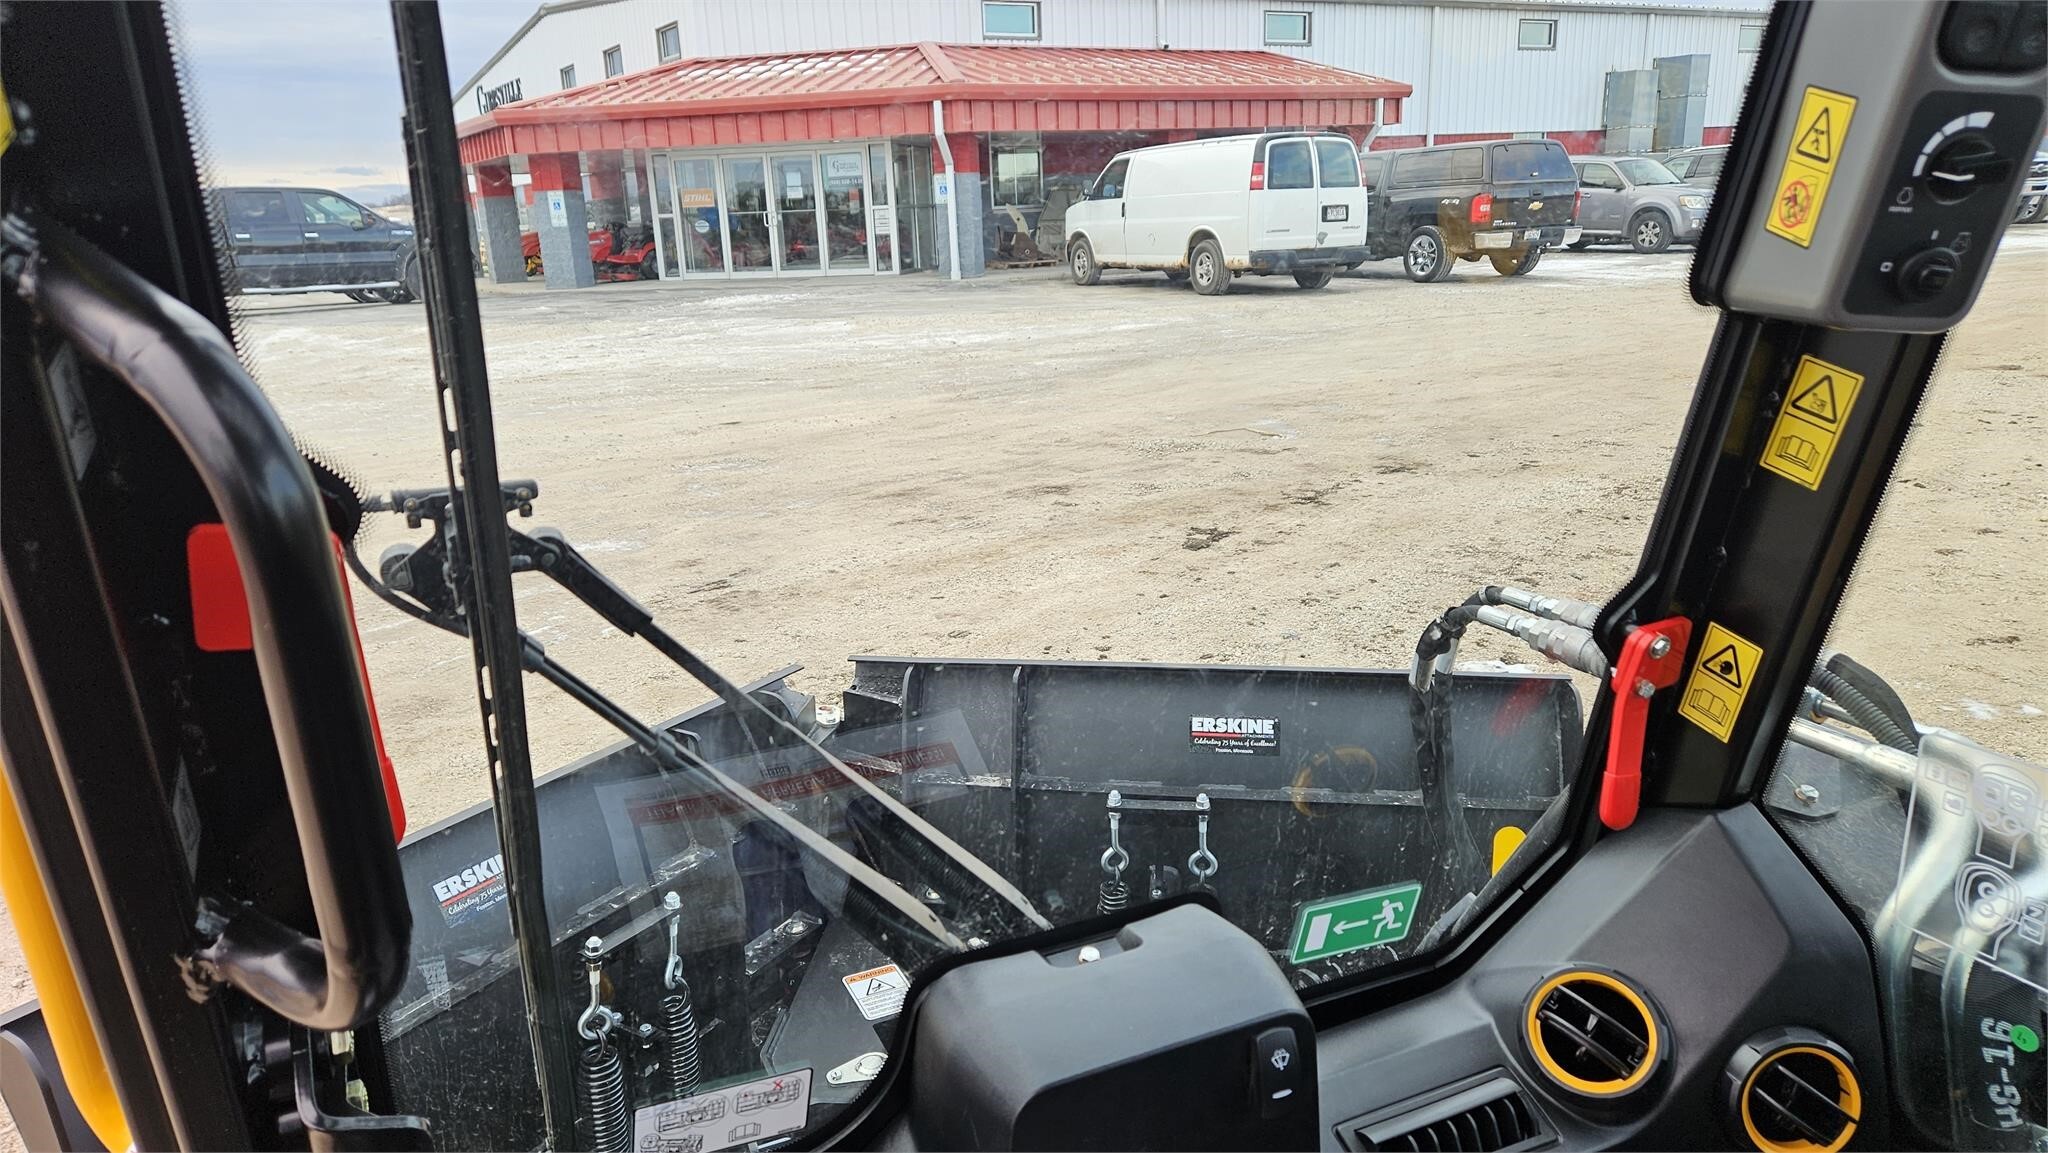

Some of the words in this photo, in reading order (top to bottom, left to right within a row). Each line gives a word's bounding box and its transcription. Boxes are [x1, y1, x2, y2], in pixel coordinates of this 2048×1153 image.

[684, 193, 711, 203] STIHL
[1191, 717, 1274, 734] ERSKINE
[1194, 737, 1221, 747] Celebrating
[1221, 739, 1229, 747] 75
[1229, 739, 1243, 747] Years
[1244, 739, 1250, 748] of
[448, 895, 480, 915] Celebrating
[479, 890, 488, 901] 75
[859, 966, 894, 980] WARNING
